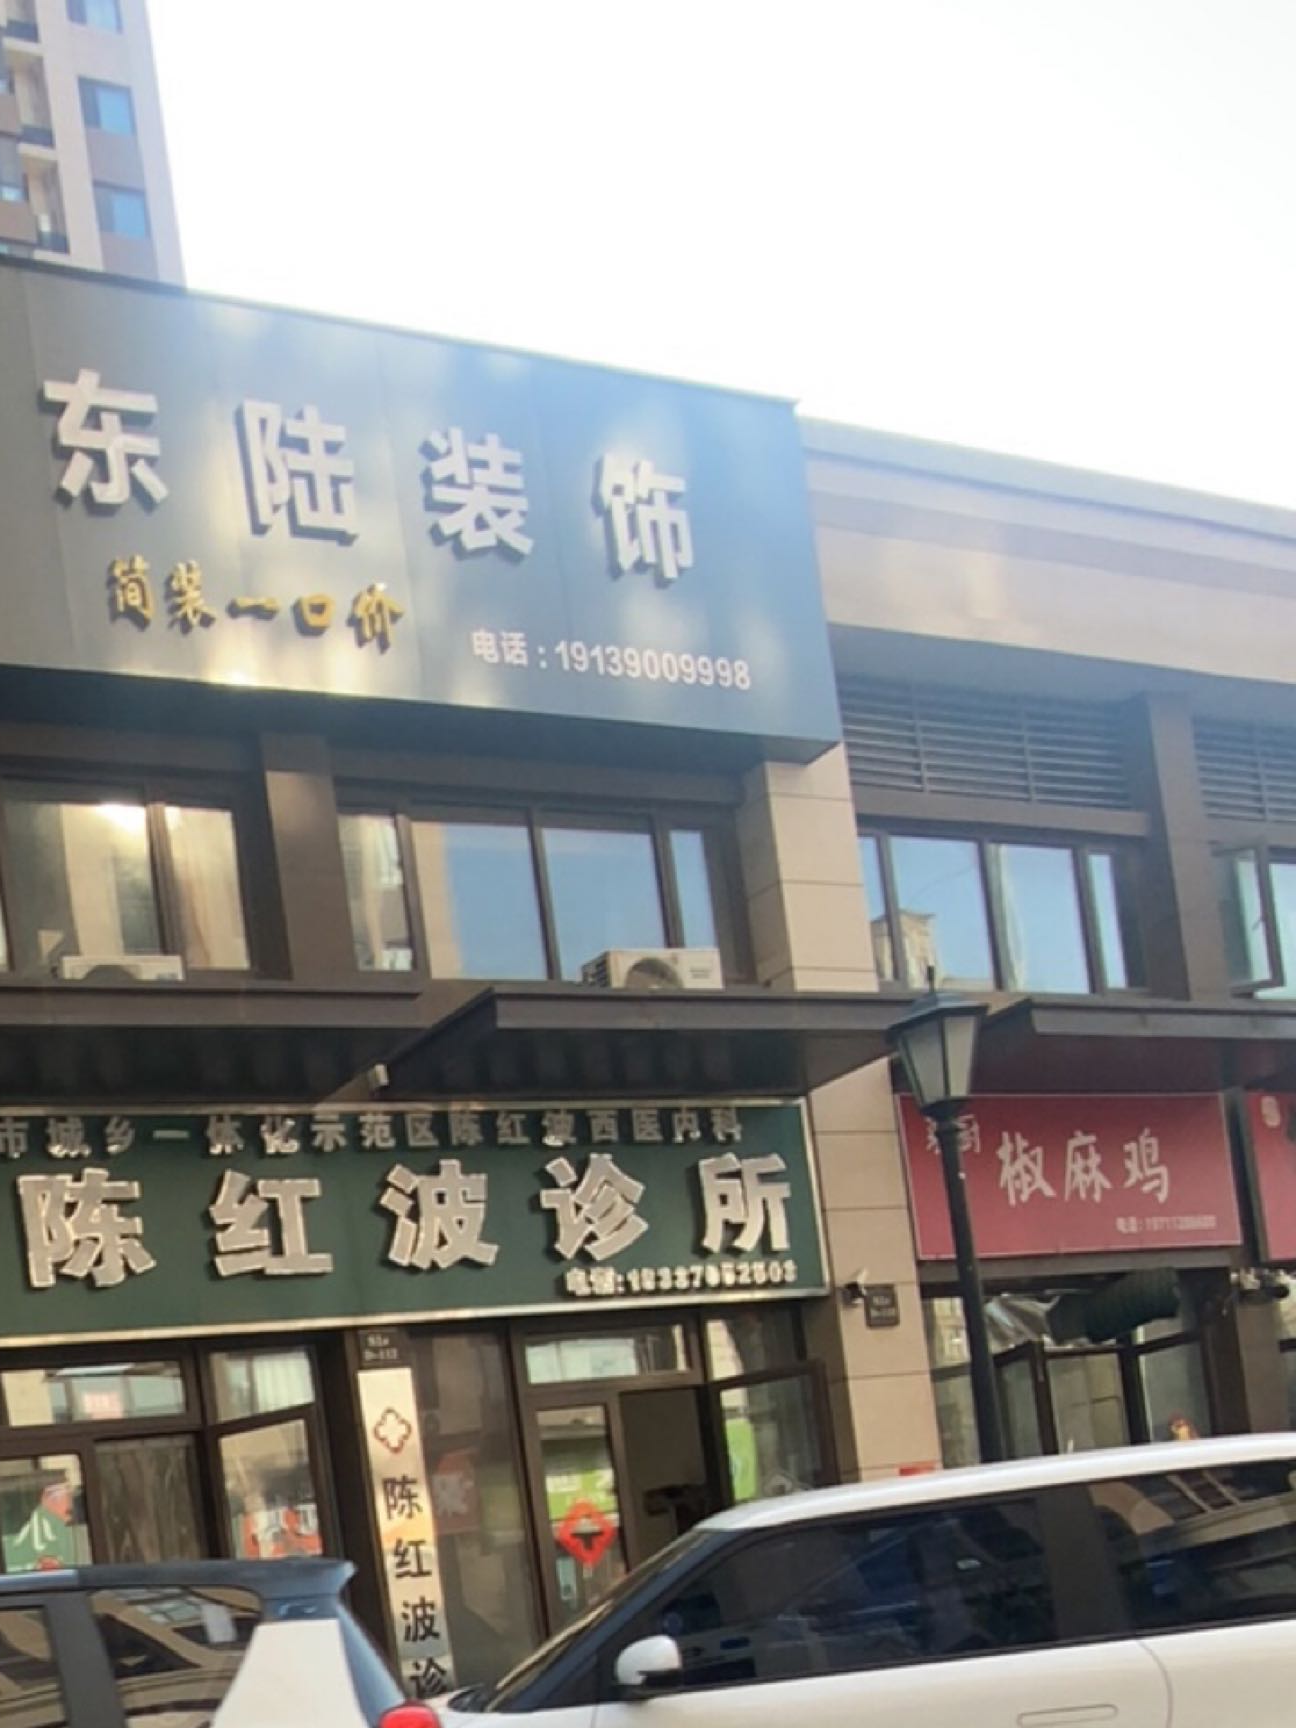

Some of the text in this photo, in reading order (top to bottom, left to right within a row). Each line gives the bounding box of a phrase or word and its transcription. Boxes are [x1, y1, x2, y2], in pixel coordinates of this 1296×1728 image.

[42, 369, 693, 580] 东陆装饰
[107, 554, 403, 647] 简装一口价
[16, 1152, 793, 1288] 陈红波诊所
[995, 1126, 1169, 1207] 椒麻鸡
[381, 1474, 449, 1699] 陈红波诊
